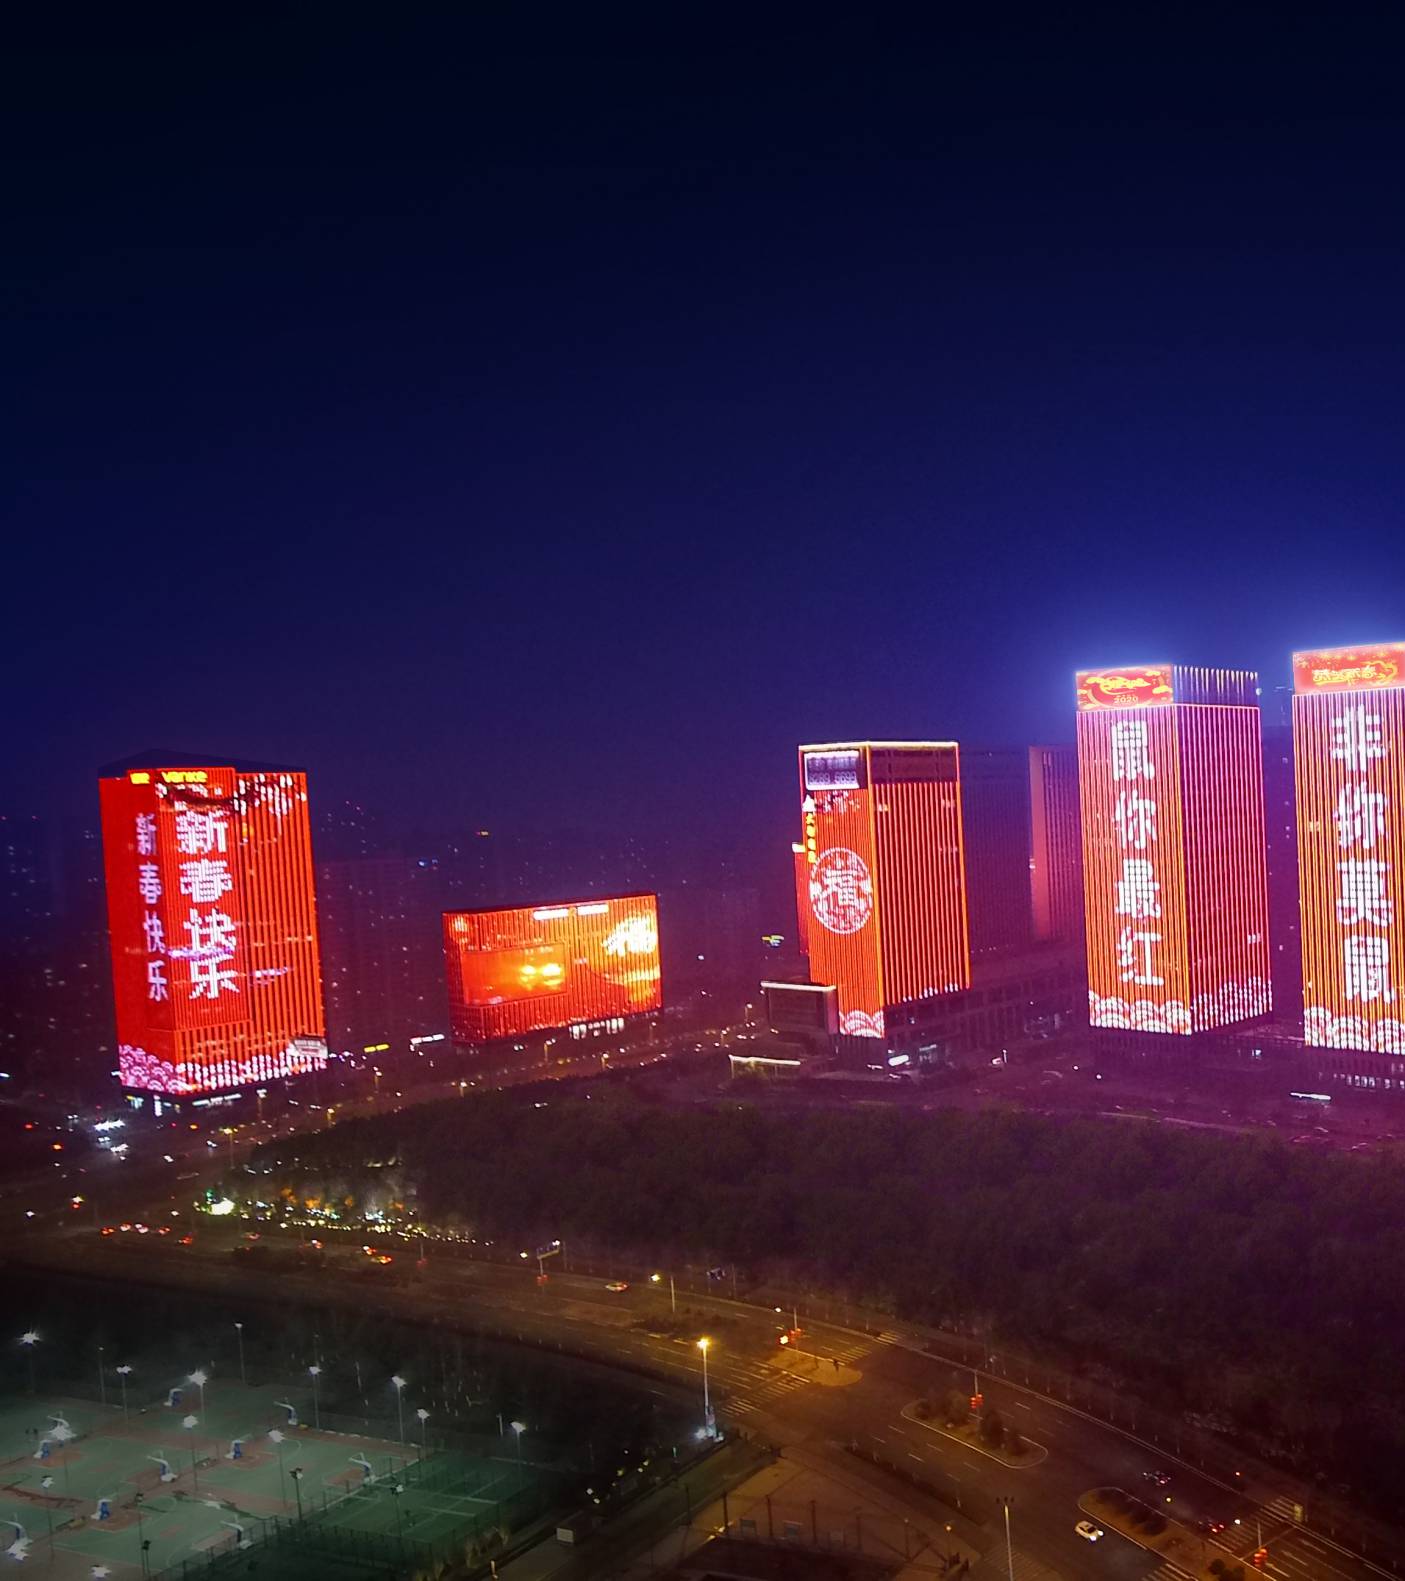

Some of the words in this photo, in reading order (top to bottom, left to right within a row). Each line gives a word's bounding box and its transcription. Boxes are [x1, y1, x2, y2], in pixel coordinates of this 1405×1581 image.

[135, 812, 168, 1001] 新春快乐
[175, 809, 240, 1000] 新春快乐
[1111, 719, 1165, 987] 鼠你最红
